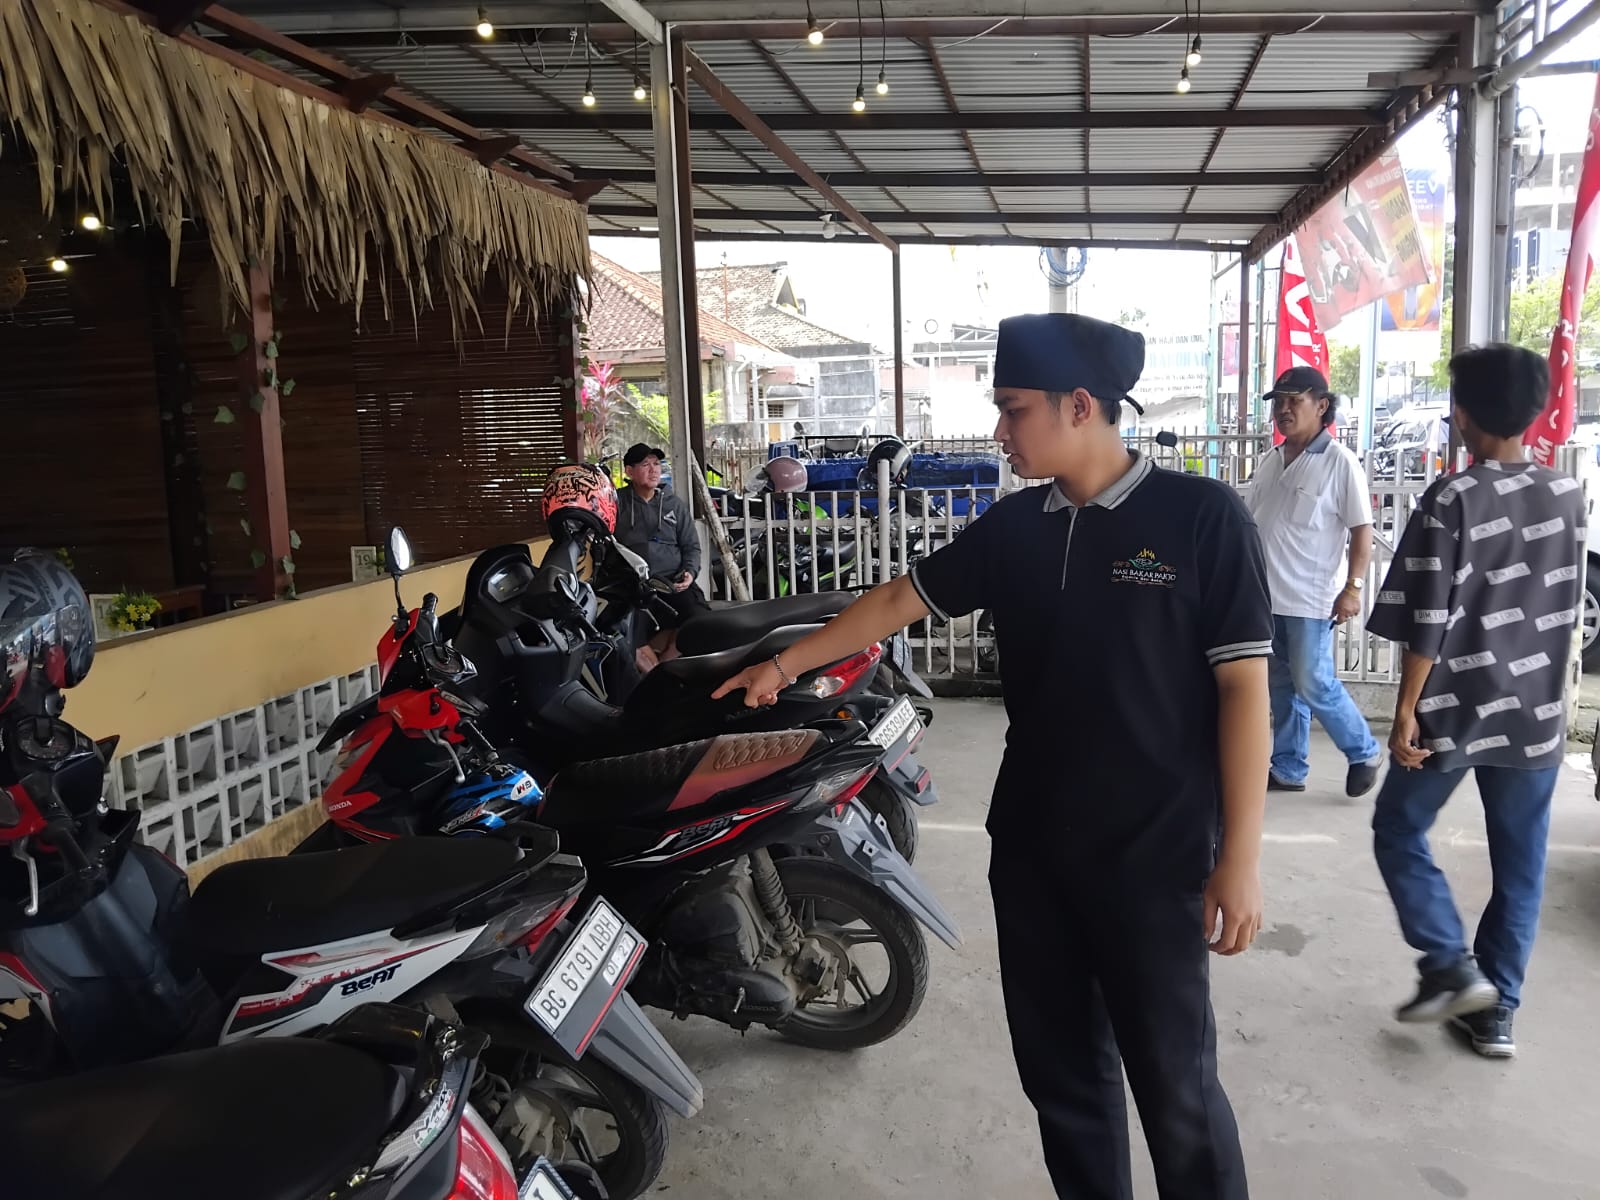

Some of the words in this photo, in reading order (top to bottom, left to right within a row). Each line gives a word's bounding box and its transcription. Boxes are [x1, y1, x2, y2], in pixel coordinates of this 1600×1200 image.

[1129, 570, 1153, 578] BAKAR
[328, 800, 353, 813] HONDA
[540, 989, 567, 1021] BG
[560, 944, 599, 992] 6791
[588, 913, 618, 952] ABH
